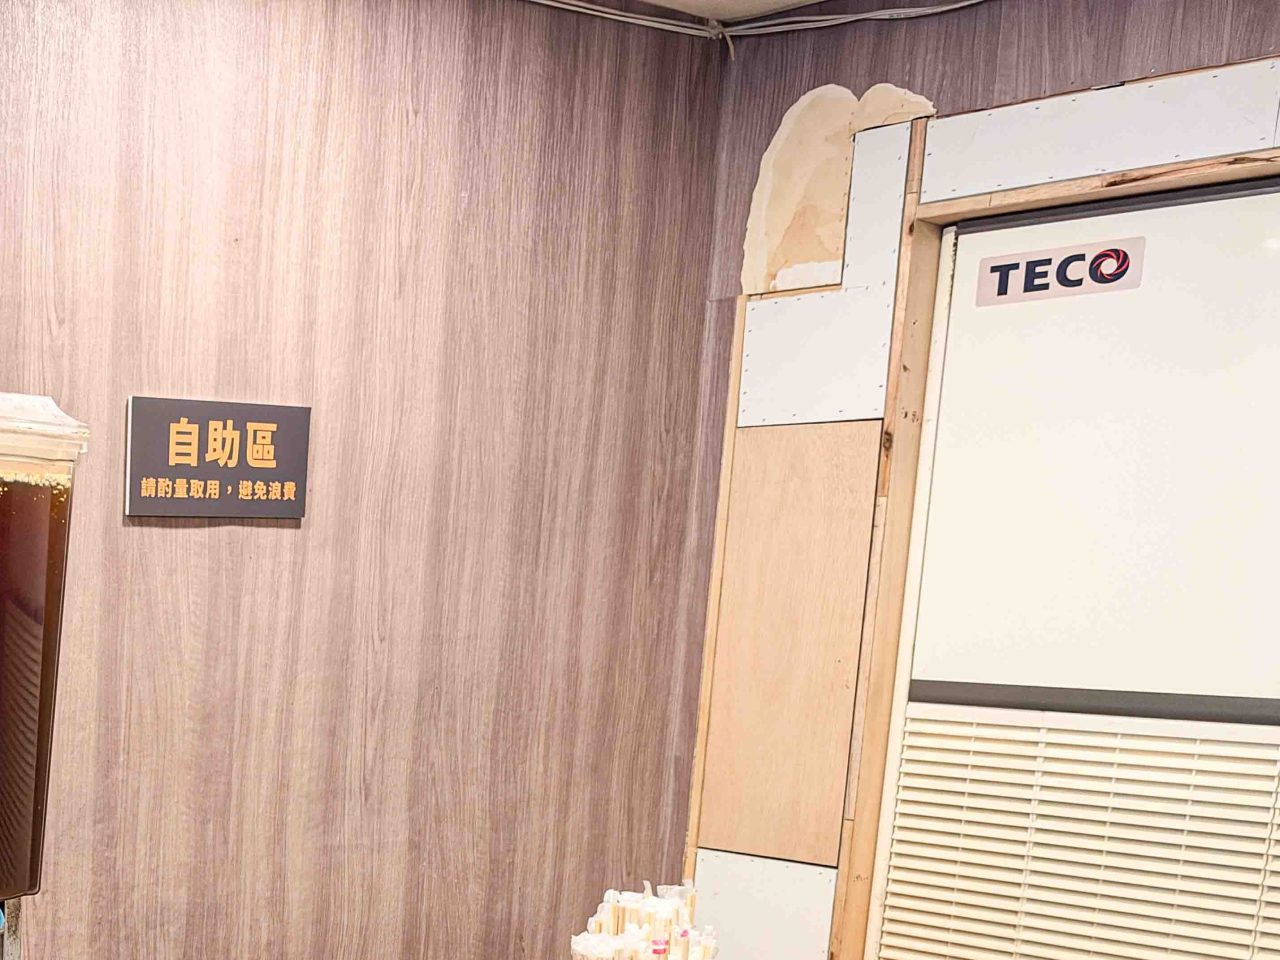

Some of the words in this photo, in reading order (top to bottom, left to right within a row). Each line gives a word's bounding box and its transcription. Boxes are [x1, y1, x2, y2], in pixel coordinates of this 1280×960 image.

[989, 248, 1130, 297] TECO
[168, 417, 278, 468] 自助區
